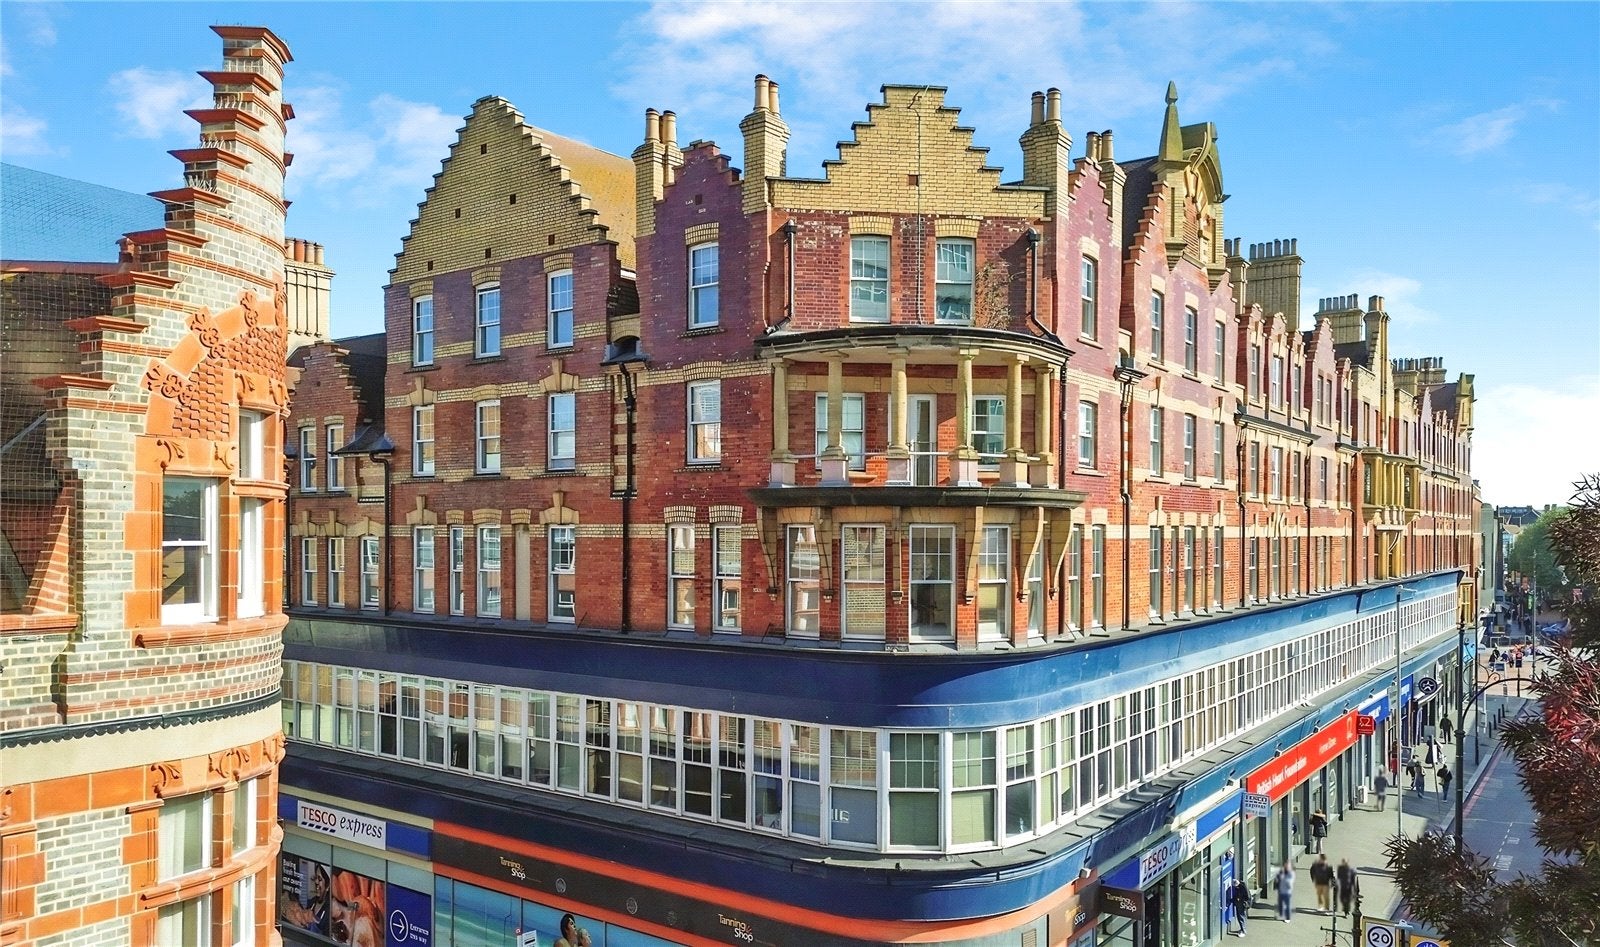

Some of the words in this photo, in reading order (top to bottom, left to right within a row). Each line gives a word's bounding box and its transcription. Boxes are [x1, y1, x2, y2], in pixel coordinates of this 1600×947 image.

[301, 806, 337, 827] TESCO
[340, 816, 383, 839] express
[500, 856, 521, 872] Tanning
[1142, 846, 1168, 874] TESCO
[511, 868, 526, 880] Shop
[1105, 892, 1131, 905] Tanning
[1120, 901, 1137, 912] Shop
[718, 913, 746, 932] Tanning
[734, 927, 754, 943] Shop
[1371, 932, 1390, 944] 20
